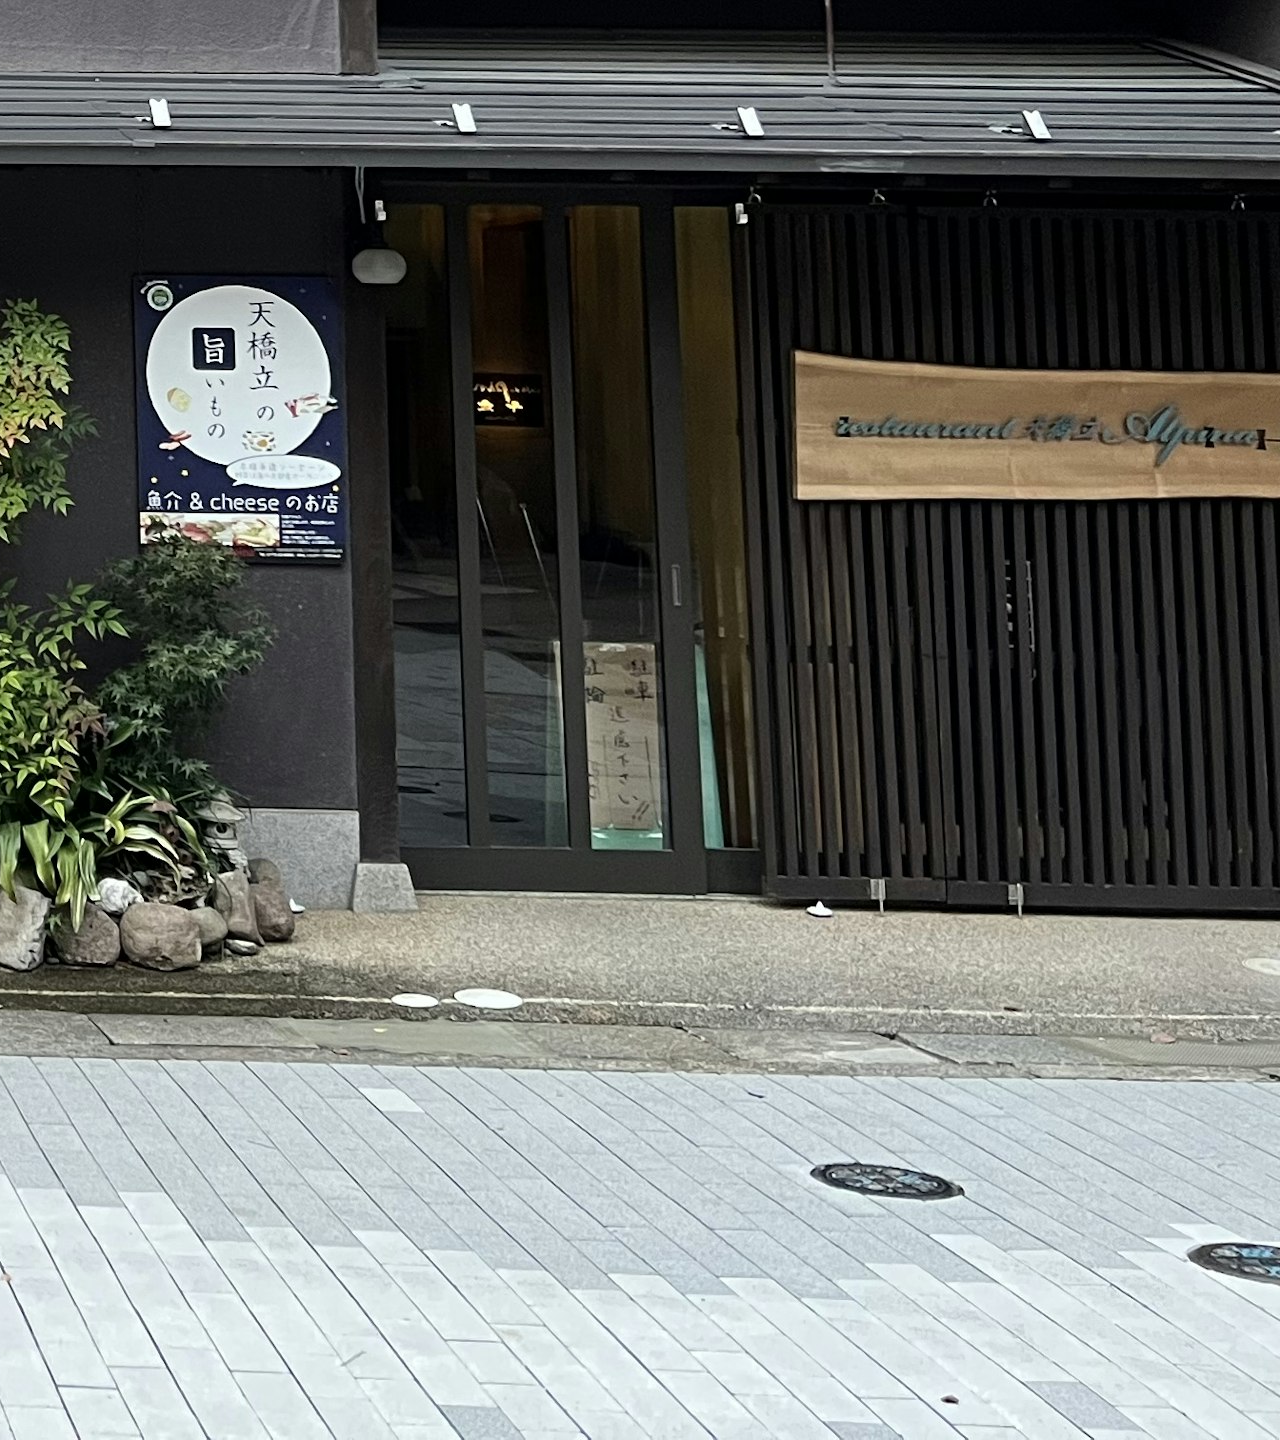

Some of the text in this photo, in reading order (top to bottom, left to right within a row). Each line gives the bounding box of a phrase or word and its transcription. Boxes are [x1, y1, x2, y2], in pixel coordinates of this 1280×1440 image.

[202, 333, 226, 439] 旨いもの
[247, 300, 279, 422] 天橋立の
[146, 490, 340, 514] 魚介 & cheese のお店
